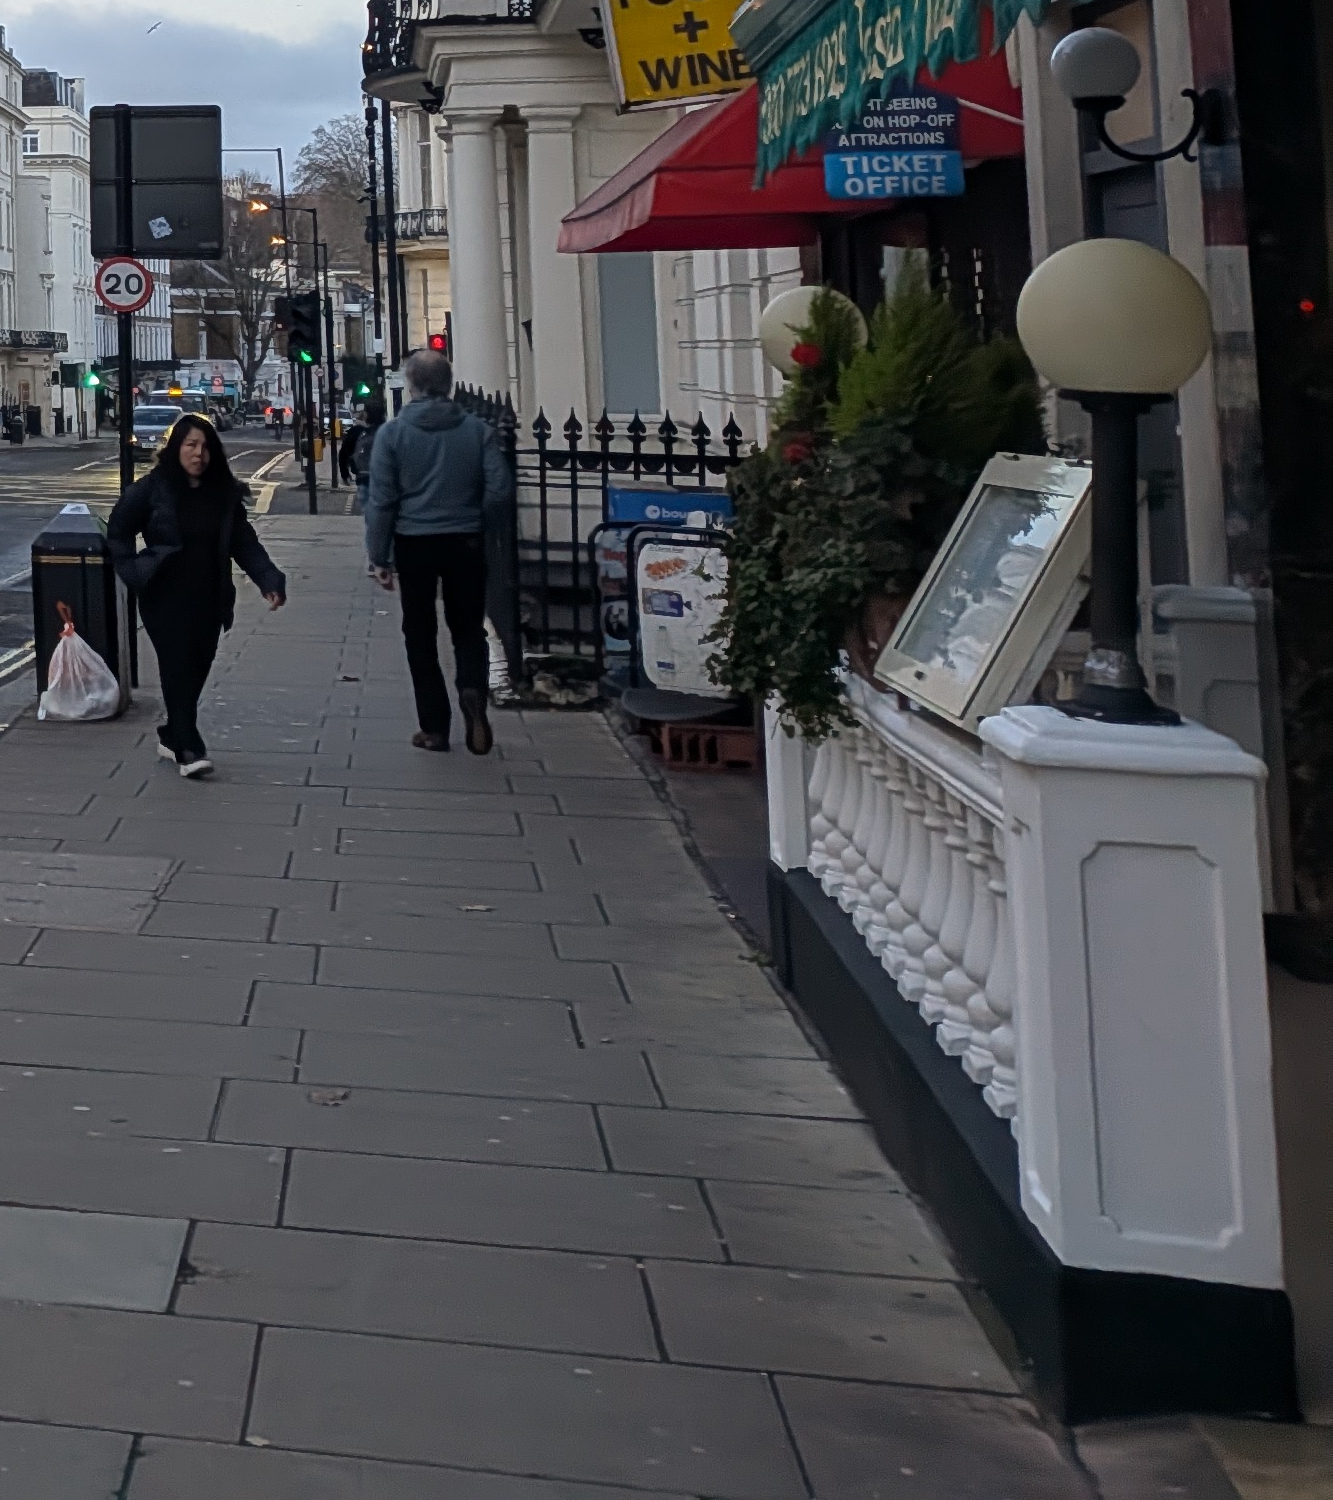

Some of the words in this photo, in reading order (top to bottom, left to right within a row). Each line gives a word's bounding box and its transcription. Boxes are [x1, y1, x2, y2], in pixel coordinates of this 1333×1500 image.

[638, 49, 757, 92] WINE
[888, 113, 956, 128] HOP-OFF
[838, 131, 945, 147] ATTRACTIONS
[840, 154, 947, 175] TICKET
[844, 175, 947, 196] OFFICE
[104, 273, 143, 295] 20
